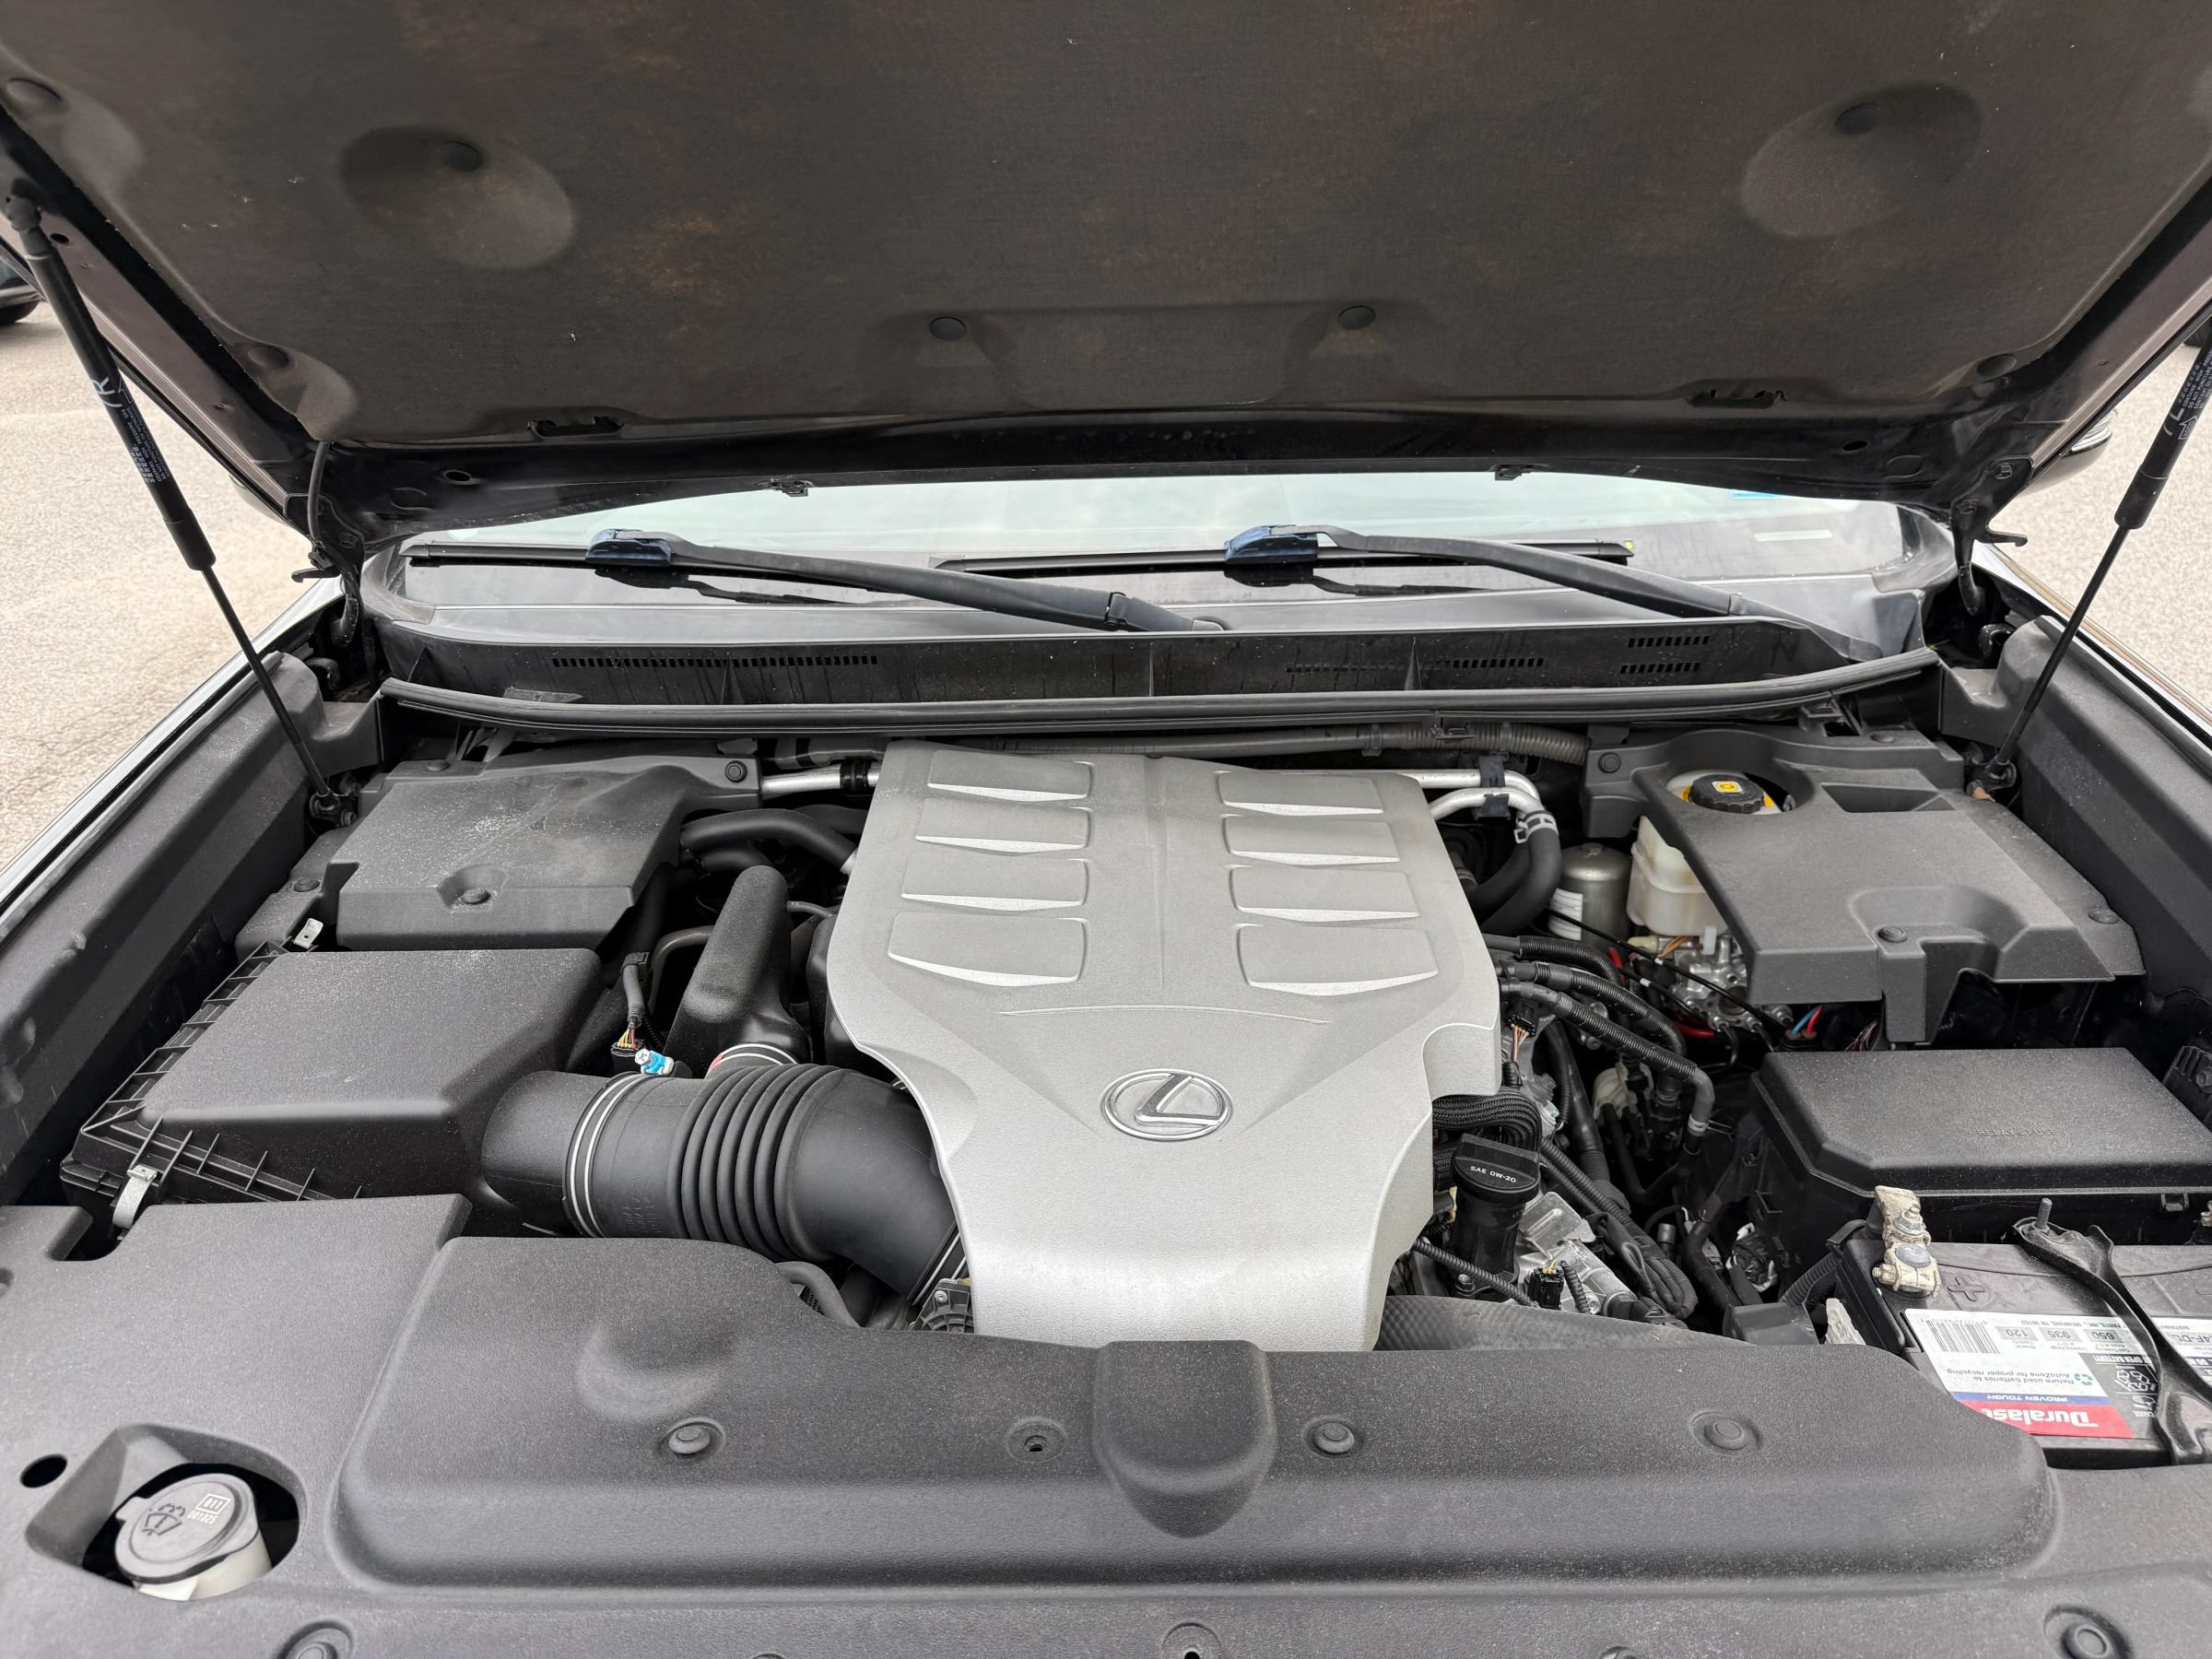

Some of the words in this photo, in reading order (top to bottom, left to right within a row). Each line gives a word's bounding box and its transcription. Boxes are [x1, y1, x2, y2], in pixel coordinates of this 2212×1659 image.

[1470, 1166, 1487, 1174] SAE
[1489, 1171, 1517, 1183] 0W-20
[2006, 1328, 2029, 1337] 120
[2047, 1330, 2071, 1339] 935
[2091, 1331, 2115, 1341] 650
[1981, 1407, 2100, 1428] Duralast
